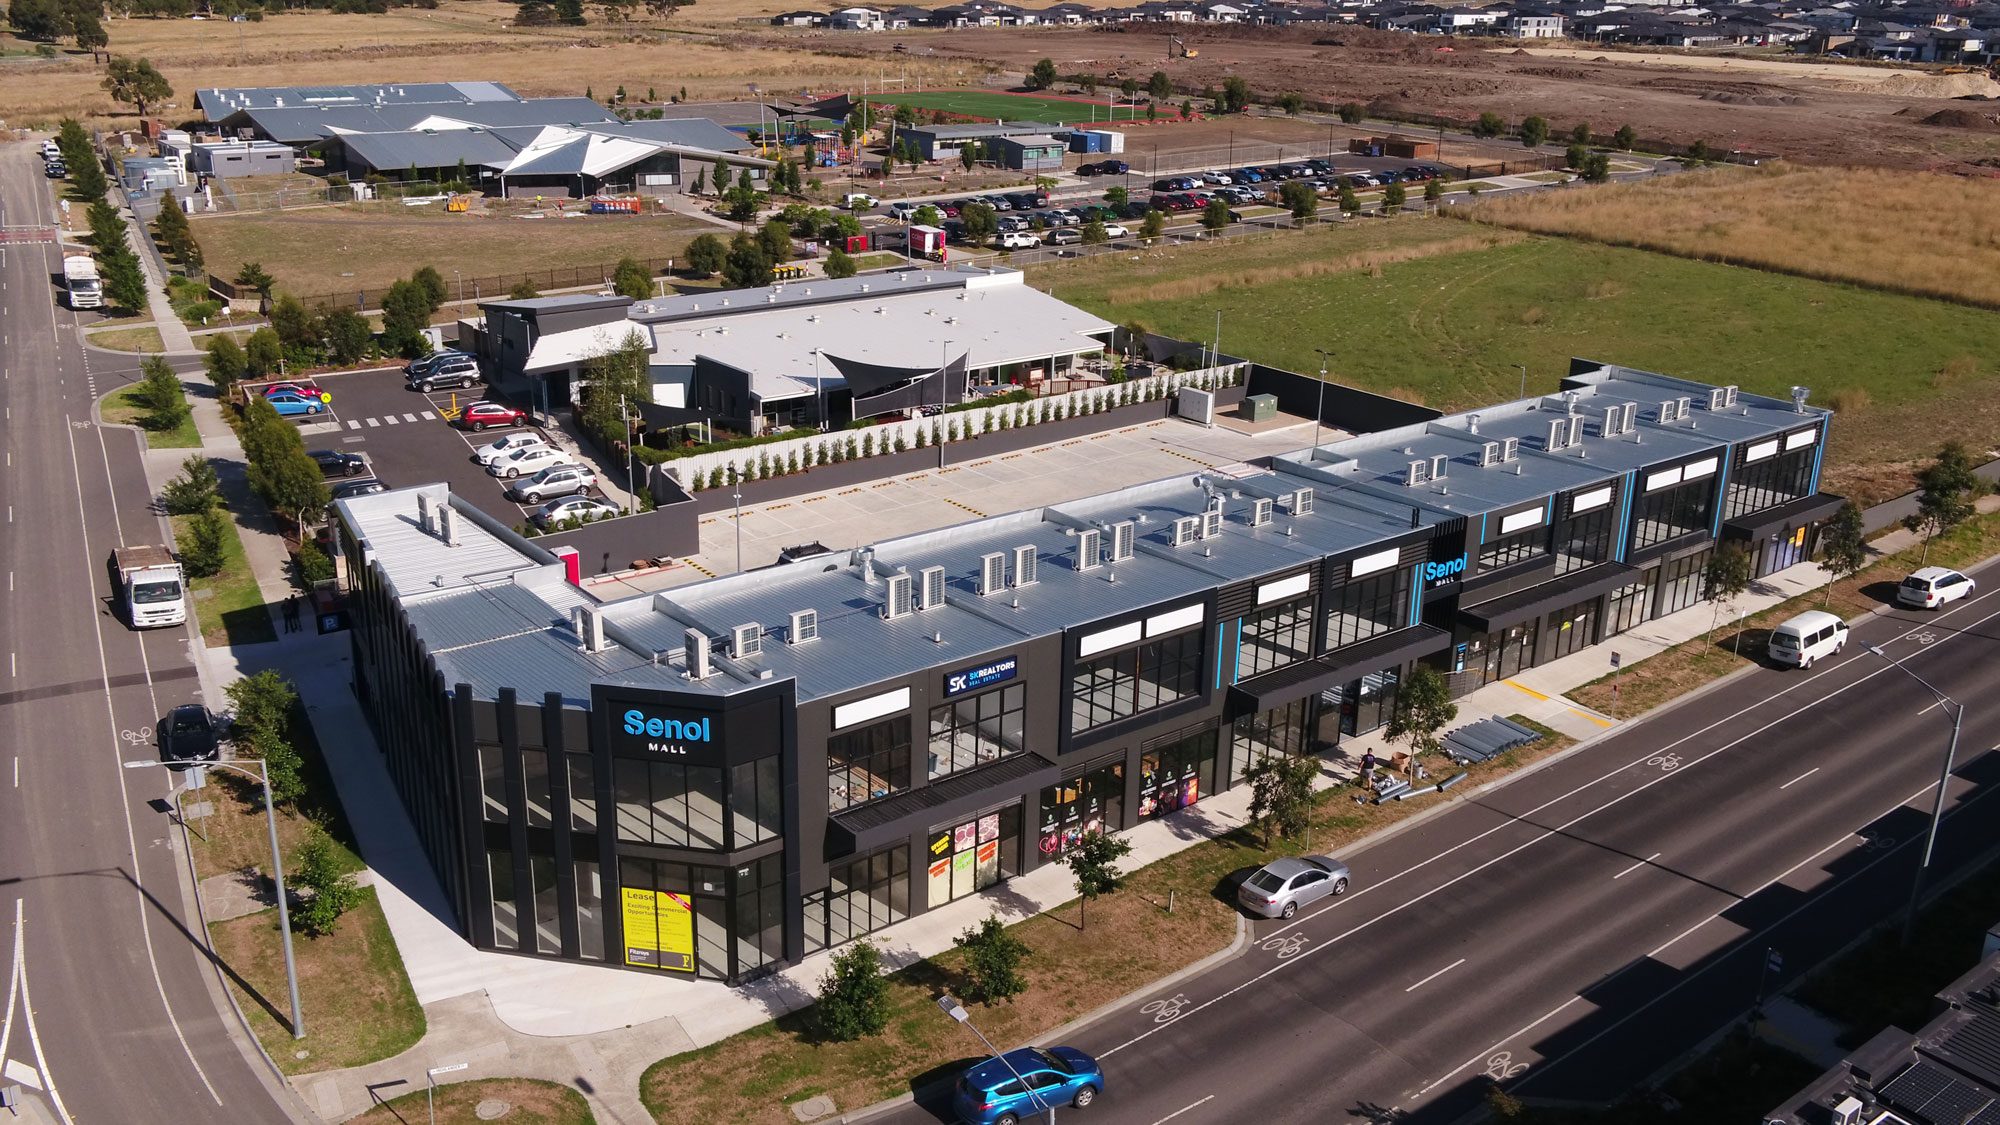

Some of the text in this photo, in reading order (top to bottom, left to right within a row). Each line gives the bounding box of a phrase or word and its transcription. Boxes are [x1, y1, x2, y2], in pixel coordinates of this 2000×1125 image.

[1425, 551, 1468, 581] Senol
[1435, 576, 1454, 587] MALL
[949, 674, 967, 693] SK
[969, 673, 1001, 687] REAL ESTATE
[623, 709, 710, 742] Senol
[648, 742, 687, 755] MALL
[627, 891, 655, 901] Lease
[627, 902, 650, 911] Exciting
[627, 908, 668, 918] Opportunties
